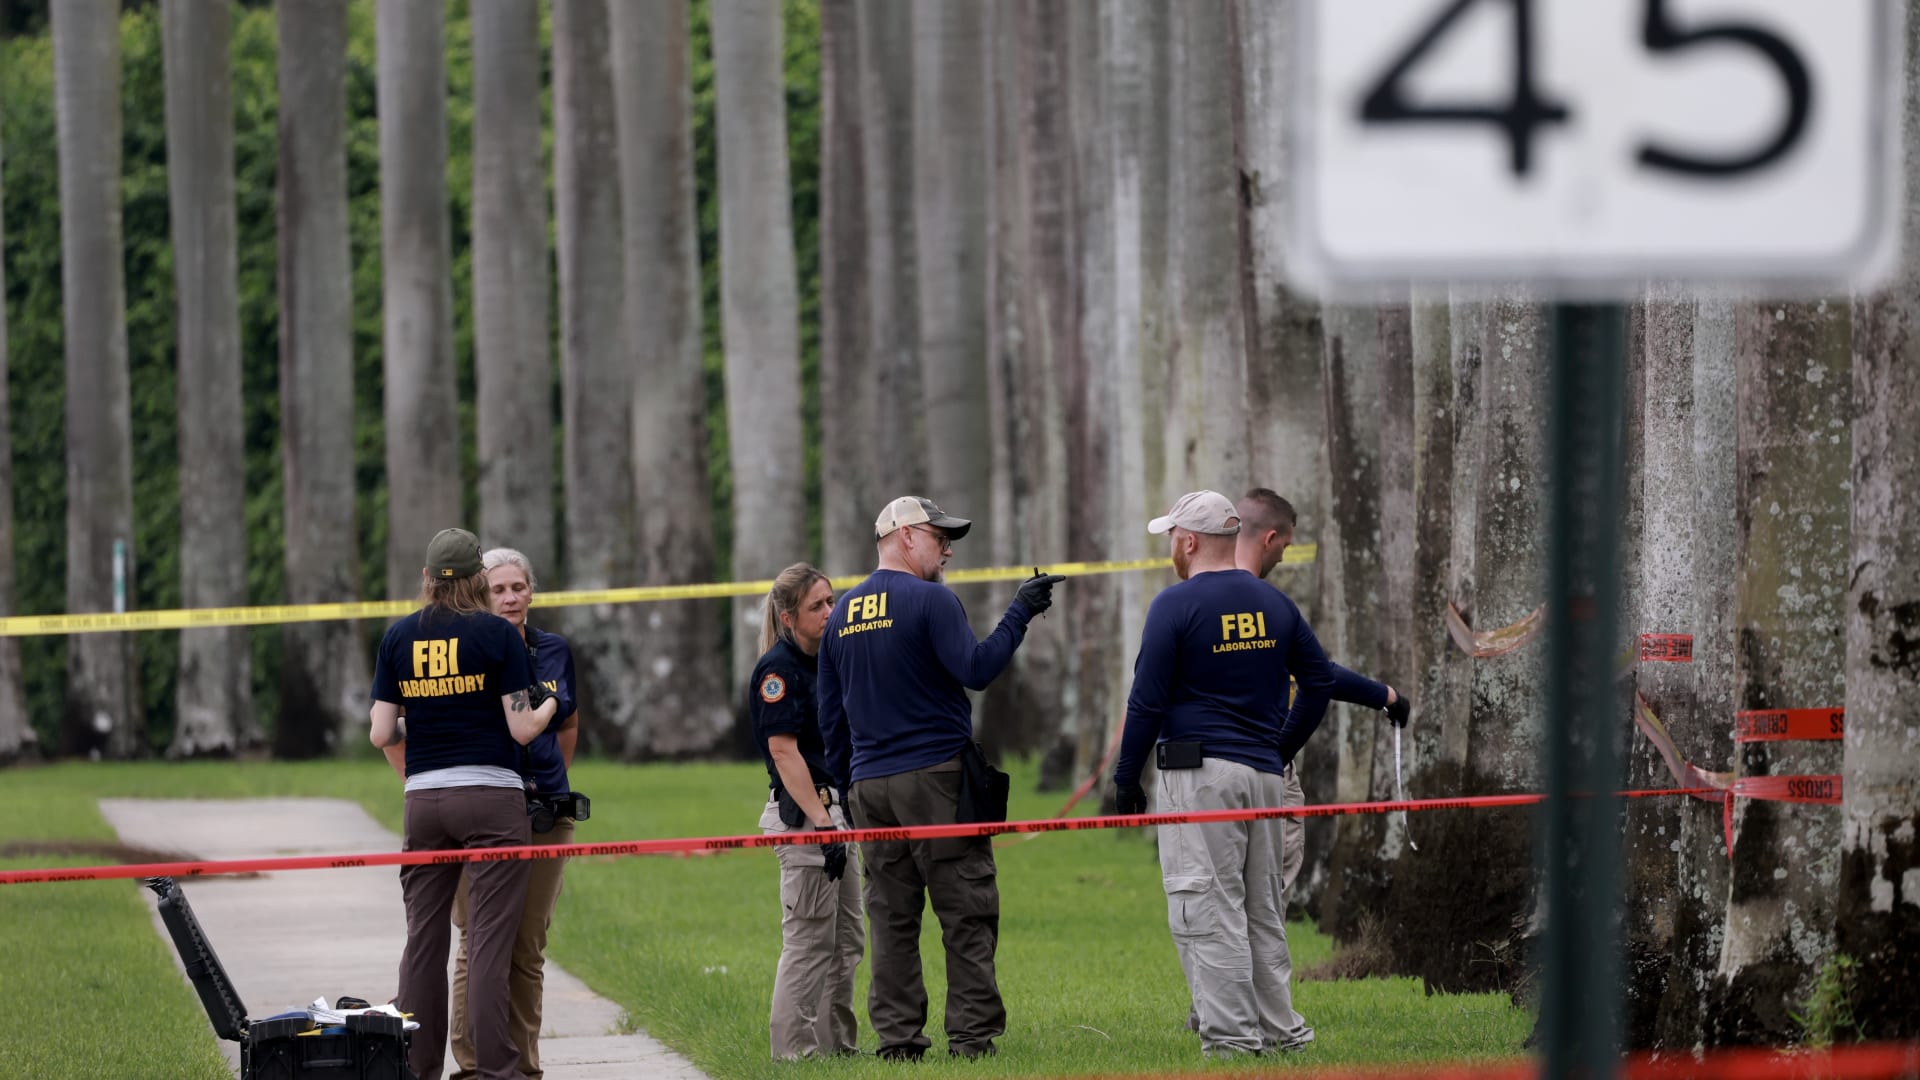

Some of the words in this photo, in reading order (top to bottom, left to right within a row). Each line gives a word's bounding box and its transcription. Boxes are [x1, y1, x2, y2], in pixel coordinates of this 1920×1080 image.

[1355, 0, 1816, 182] 45
[847, 592, 887, 623] FBI
[838, 618, 893, 637] LABORATORY
[1221, 611, 1266, 641] FBI
[412, 637, 460, 678] FBI
[1213, 638, 1277, 653] LABORATORY
[398, 673, 486, 698] LABORATORY
[1788, 780, 1833, 799] CROSS
